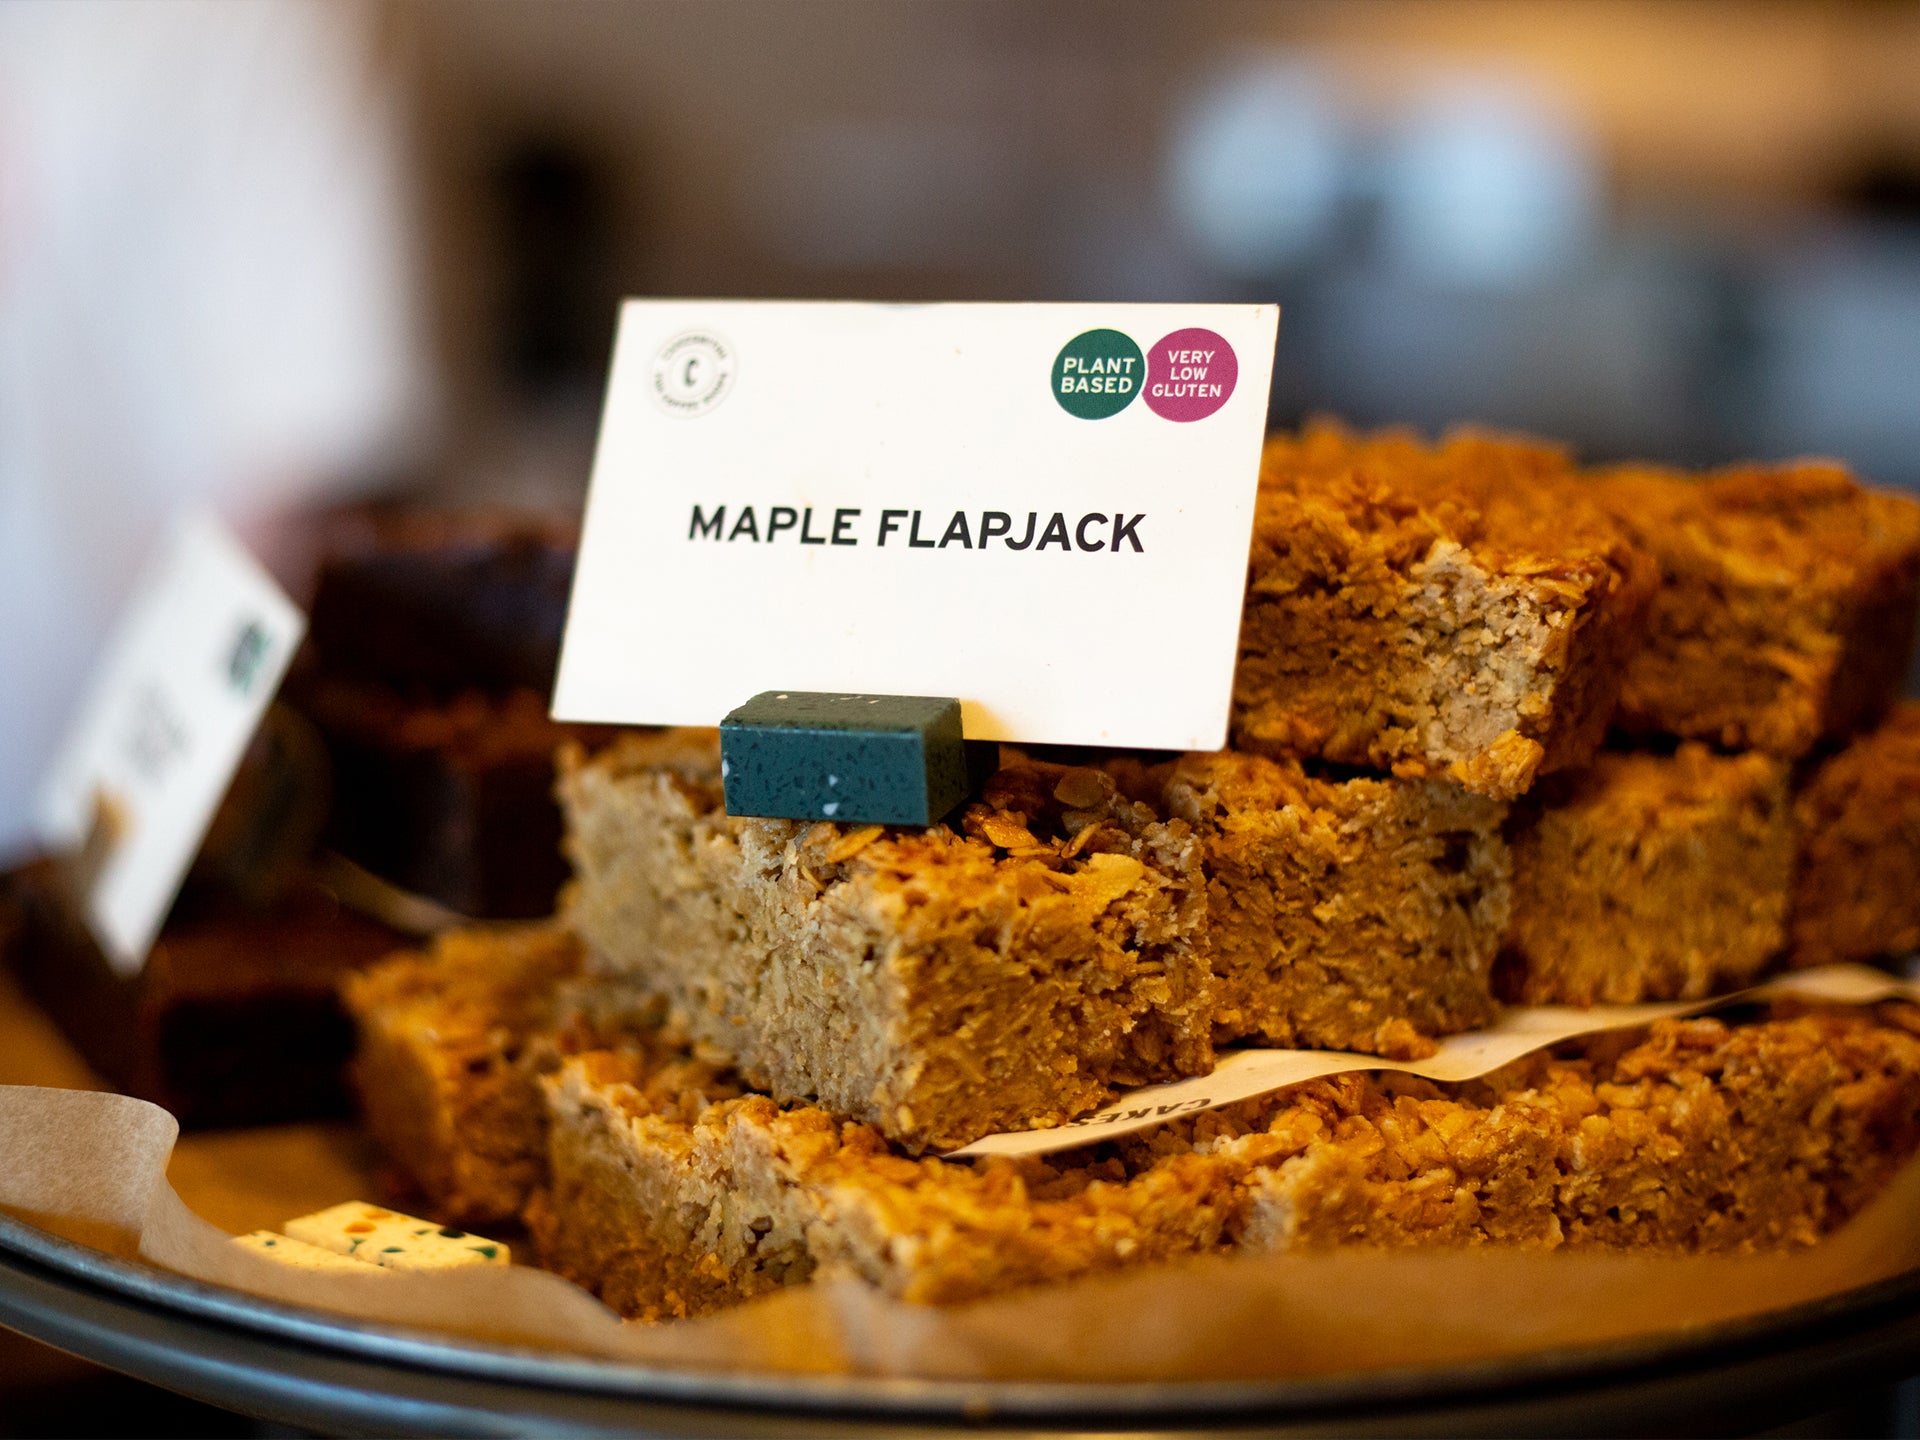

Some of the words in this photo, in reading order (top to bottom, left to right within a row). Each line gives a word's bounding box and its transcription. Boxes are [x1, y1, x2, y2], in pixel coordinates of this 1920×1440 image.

[1063, 357, 1136, 374] PLANT
[1168, 350, 1215, 364] VERY
[683, 357, 700, 388] C
[1170, 367, 1208, 381] LOW
[1061, 377, 1133, 394] BASED
[1152, 384, 1222, 398] GLUTEN
[688, 504, 862, 546] MAPLE
[877, 509, 1146, 553] FLAPJACK
[1065, 1098, 1211, 1128] CAKES
